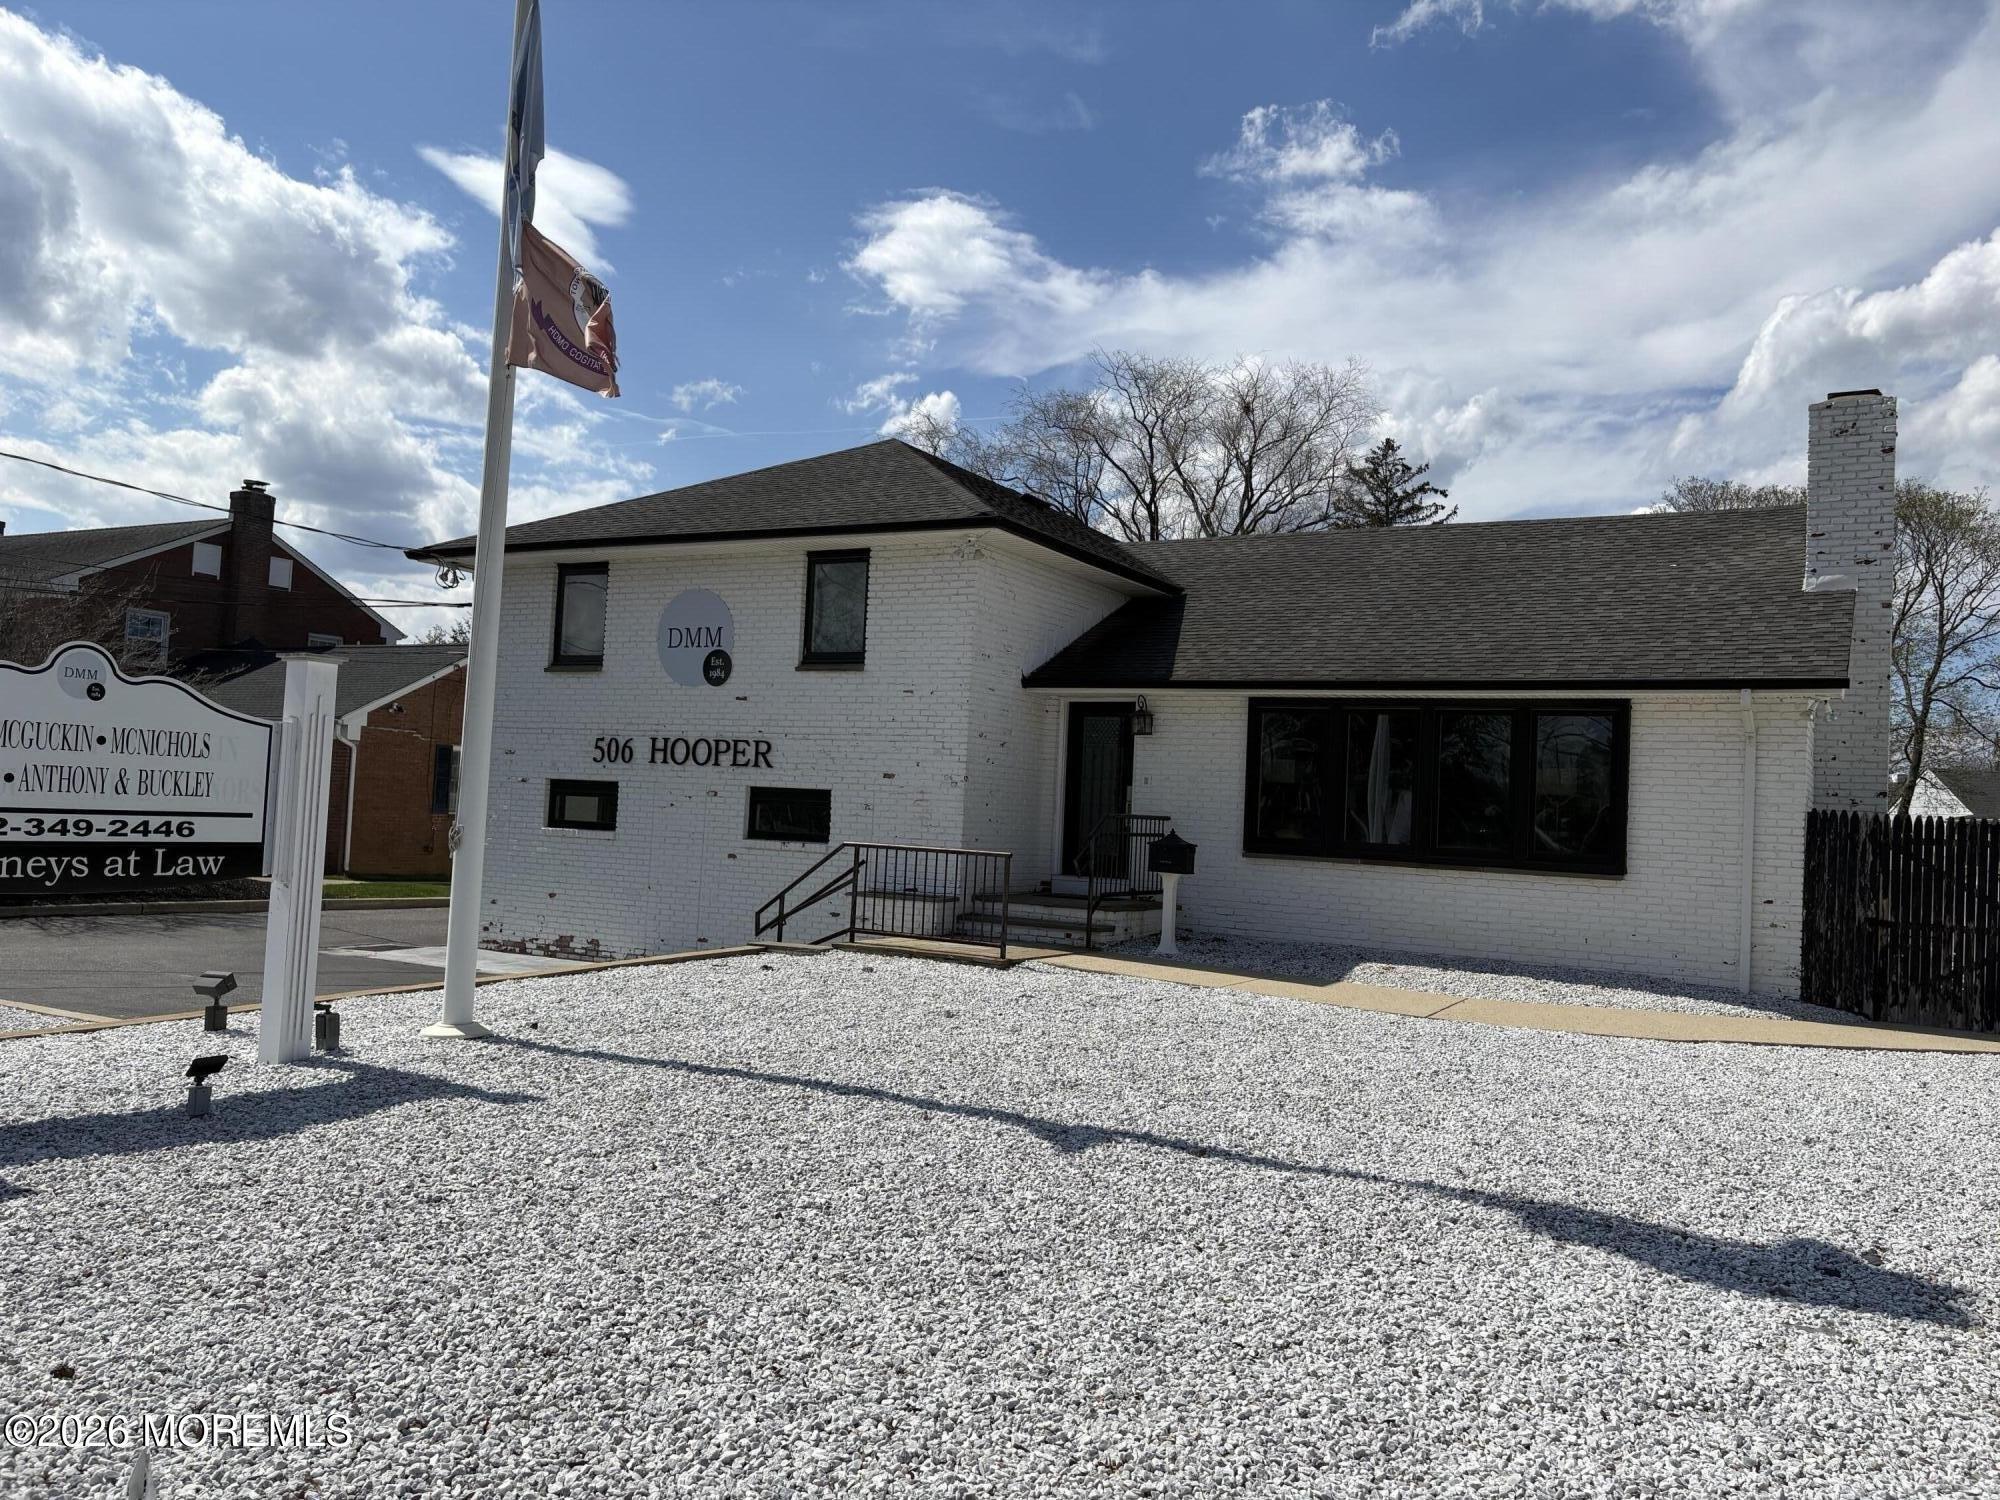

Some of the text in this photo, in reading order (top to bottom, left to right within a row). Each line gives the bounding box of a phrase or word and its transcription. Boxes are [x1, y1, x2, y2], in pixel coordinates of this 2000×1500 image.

[667, 627, 724, 649] DMM
[64, 666, 98, 680] DMM
[709, 668, 725, 679] 1984
[711, 656, 725, 666] Est.
[110, 727, 211, 758] MCNICHOLS
[593, 737, 774, 768] 506 HOOPER
[18, 762, 109, 794] ANTHONY
[114, 767, 130, 795] &
[137, 769, 214, 797] BUCKLEY
[103, 850, 140, 877] at
[153, 848, 225, 876] Law
